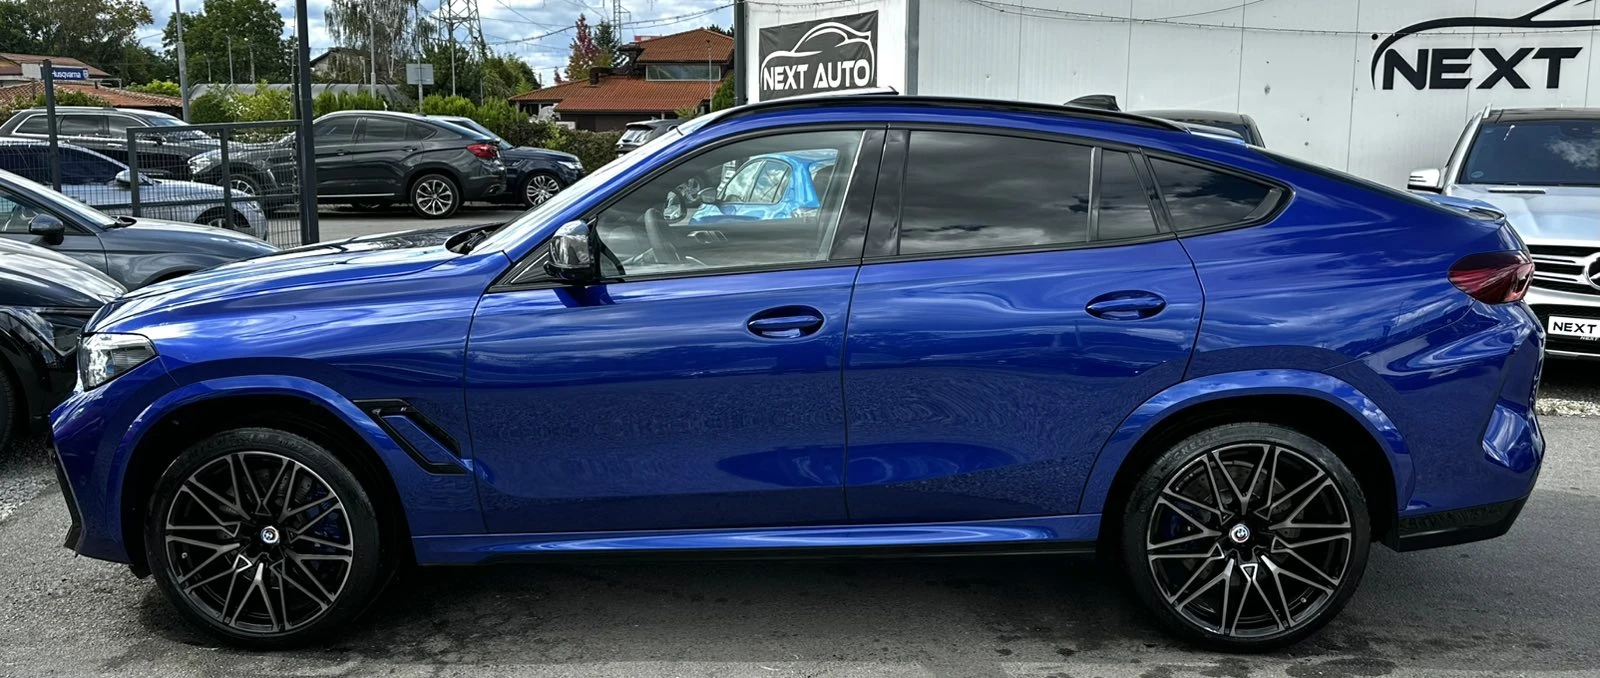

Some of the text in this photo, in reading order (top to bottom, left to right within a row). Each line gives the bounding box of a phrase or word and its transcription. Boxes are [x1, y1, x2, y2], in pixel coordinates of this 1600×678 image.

[763, 59, 870, 91] NEXT AUTO
[1382, 47, 1583, 90] NEXT
[1553, 321, 1597, 334] NEXT
